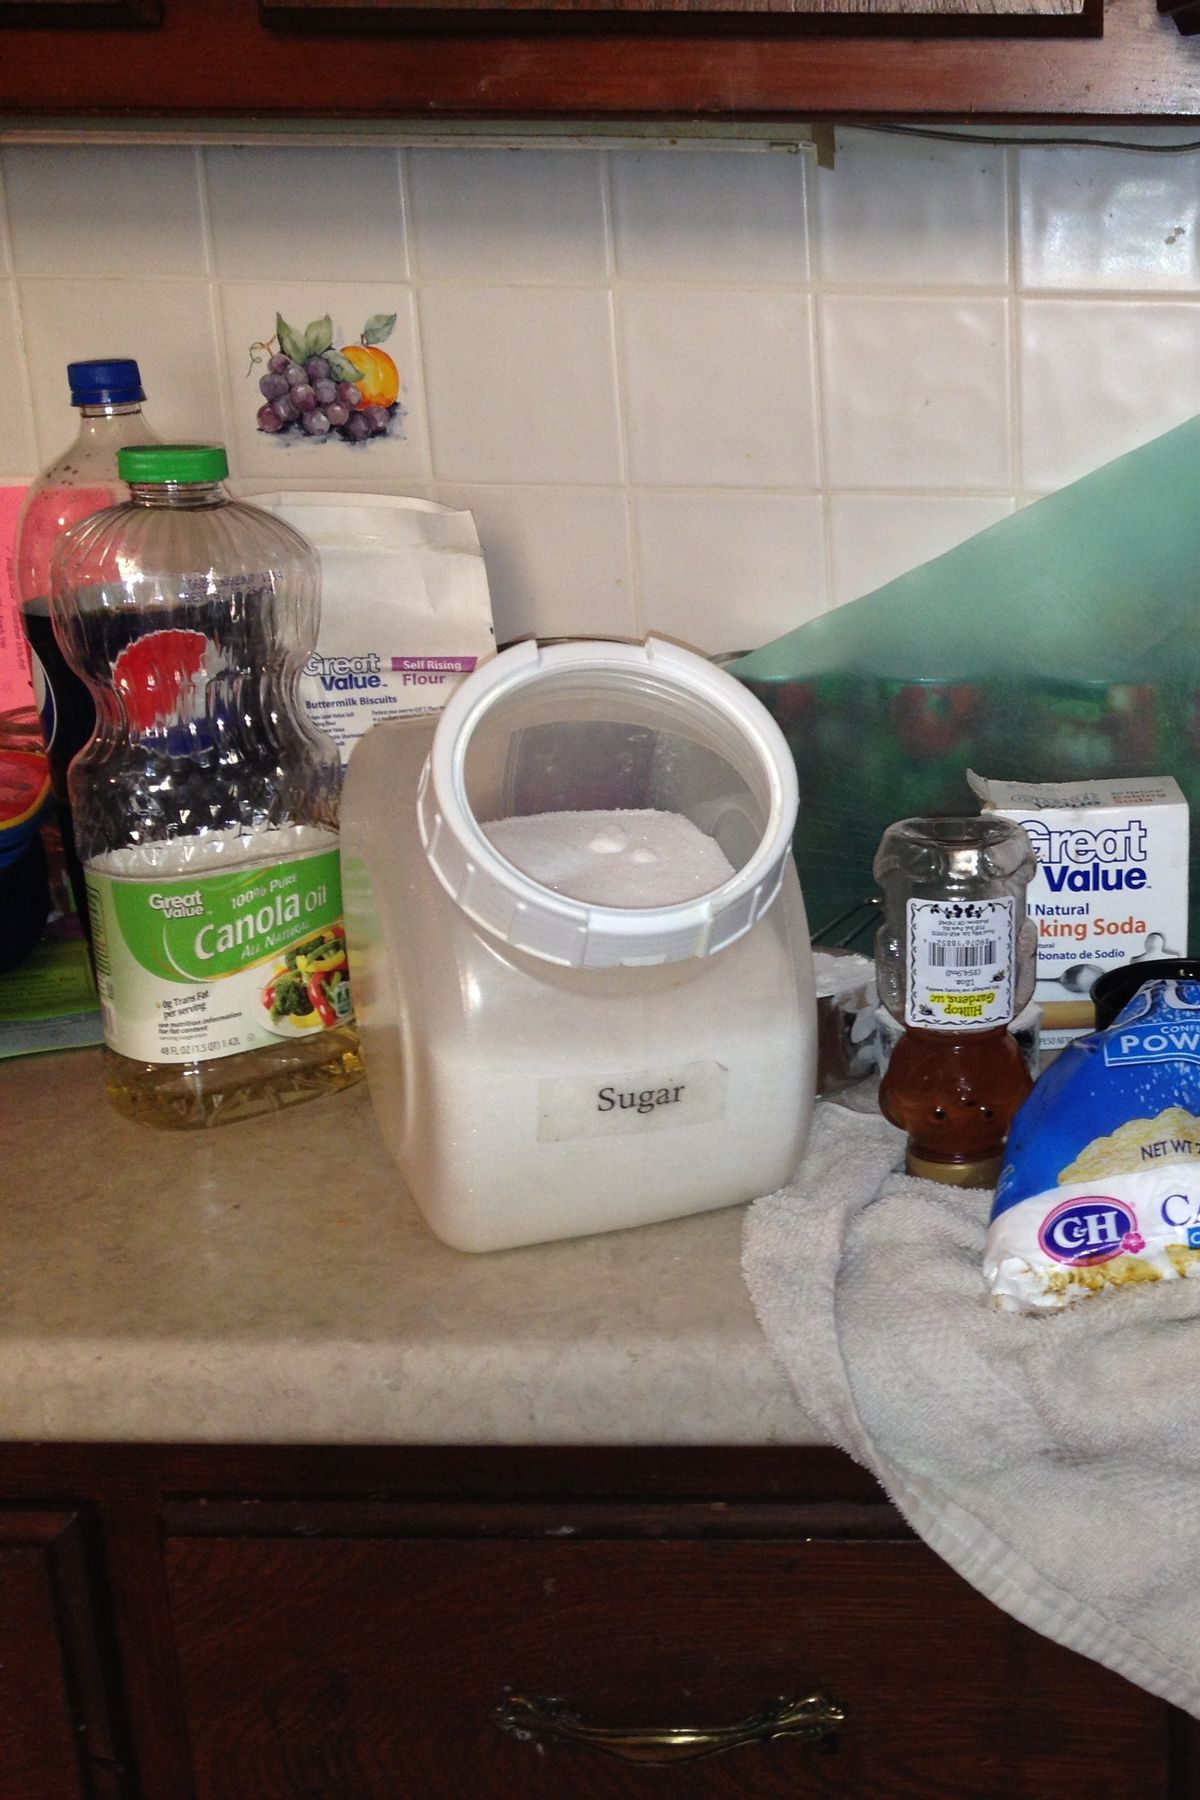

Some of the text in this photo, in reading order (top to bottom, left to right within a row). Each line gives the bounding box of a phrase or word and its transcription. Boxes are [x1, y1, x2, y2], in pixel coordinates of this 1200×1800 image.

[303, 652, 381, 676] Great
[403, 660, 462, 671] Self Rising
[320, 673, 381, 691] Value
[403, 673, 446, 686] Flour
[305, 695, 398, 710] Buttermilk Biscuits
[1018, 820, 1147, 864] Great
[1043, 862, 1148, 892] Value
[149, 890, 203, 910] Great
[232, 886, 267, 909] 100%
[163, 904, 204, 919] Value
[1035, 903, 1089, 916] Natural
[194, 885, 328, 960] Canola Oil
[1039, 916, 1147, 941] king Soda
[240, 944, 262, 960] ALL
[1037, 949, 1125, 961] bonato de Sodio
[173, 995, 196, 1006] Trans
[196, 990, 209, 1000] Fat
[163, 1002, 207, 1019] per serving
[944, 1004, 983, 1017] Hilltop
[597, 1084, 686, 1114] Sugar
[1141, 1141, 1168, 1160] NET
[1169, 1139, 1192, 1156] WT
[1053, 1211, 1122, 1249] C&H
